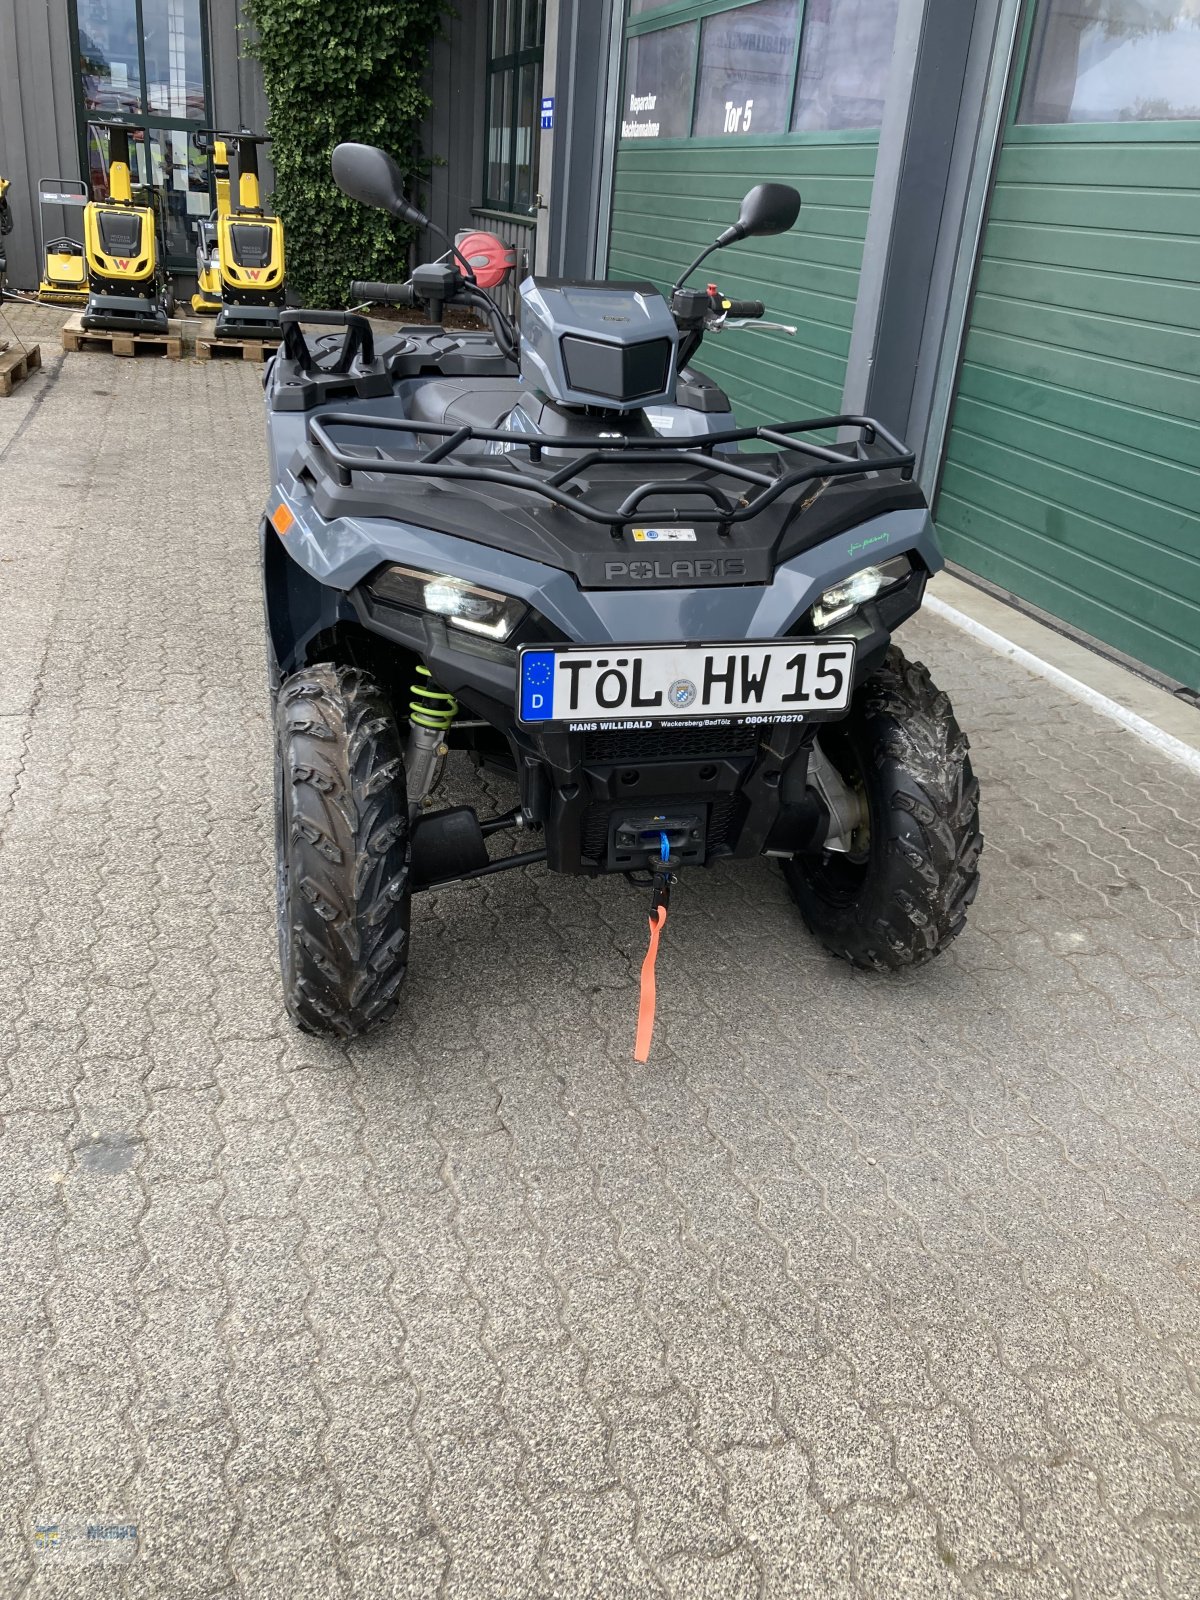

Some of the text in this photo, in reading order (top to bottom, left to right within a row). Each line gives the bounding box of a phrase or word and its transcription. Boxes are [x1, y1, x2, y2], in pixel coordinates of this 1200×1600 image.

[630, 92, 657, 115] Reparatur
[723, 99, 754, 133] Tor 5
[604, 559, 747, 580] POLARIS
[559, 658, 663, 710] TÖL
[701, 654, 772, 705] HW
[781, 652, 847, 703] 15
[531, 694, 544, 709] D
[569, 722, 598, 732] HANS
[599, 720, 653, 731] WILLIBALD
[745, 714, 804, 724] 08041/78270
